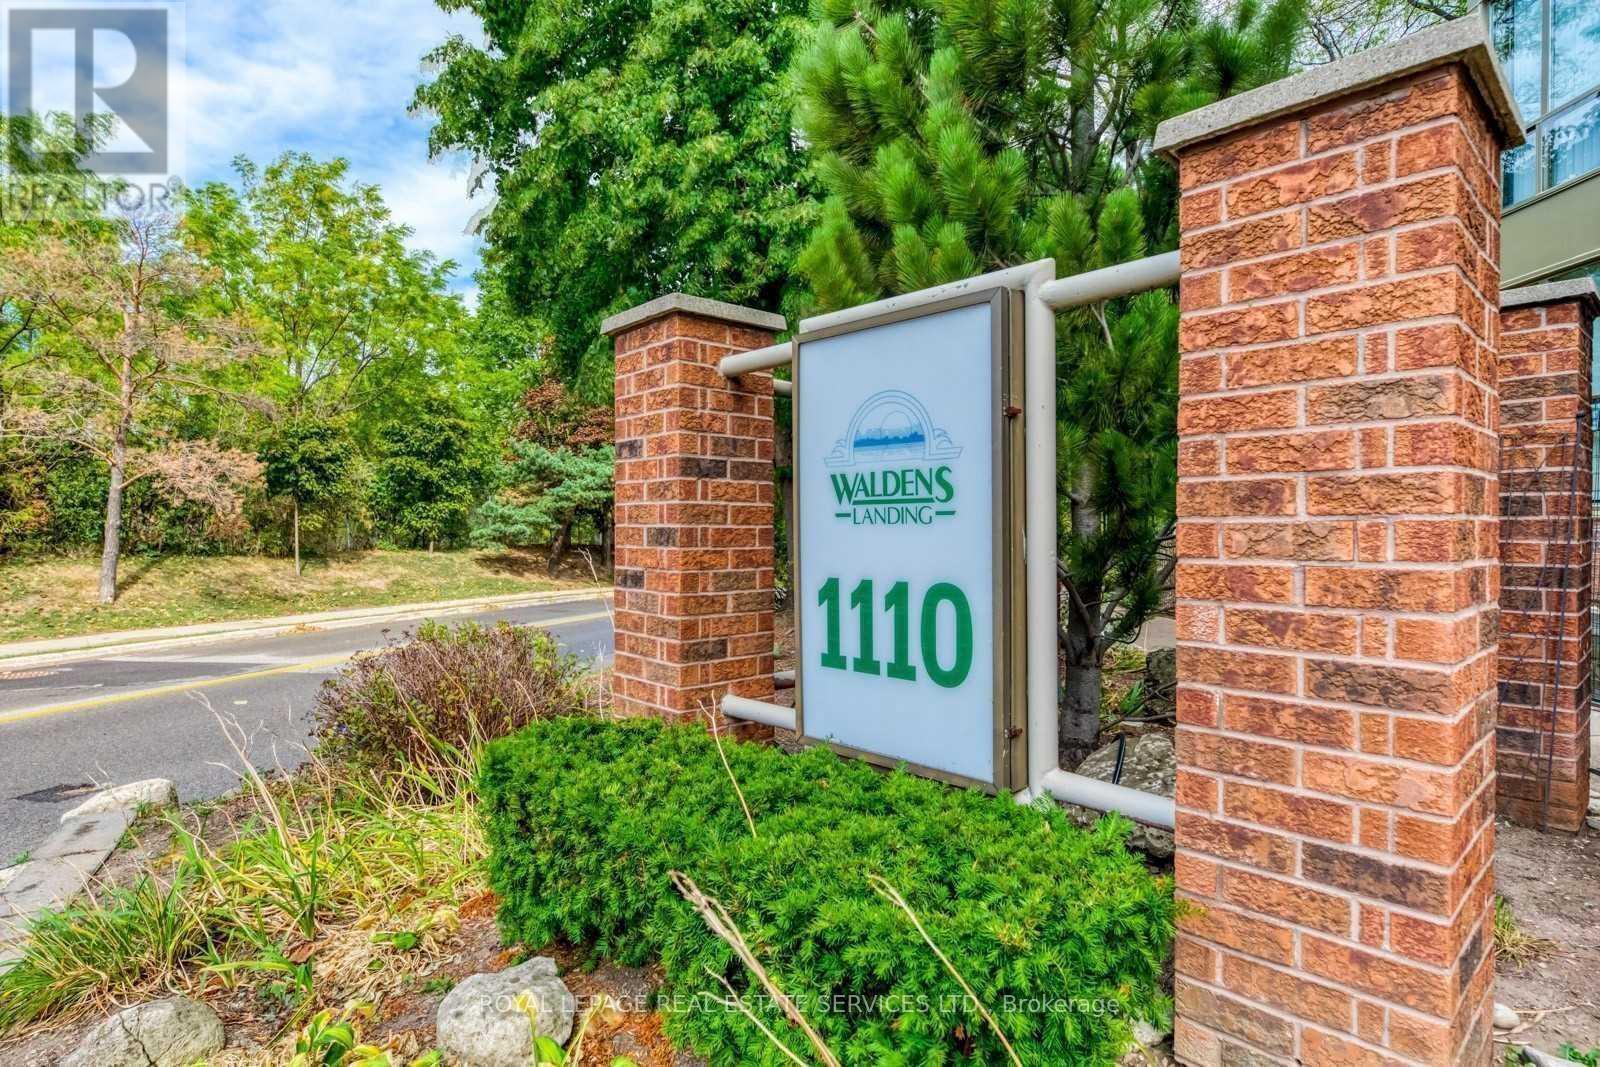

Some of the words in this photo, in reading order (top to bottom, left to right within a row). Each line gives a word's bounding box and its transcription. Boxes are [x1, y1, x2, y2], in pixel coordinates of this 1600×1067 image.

[830, 465, 954, 505] WALDENS
[852, 506, 933, 526] LANDING
[817, 576, 974, 689] 1110
